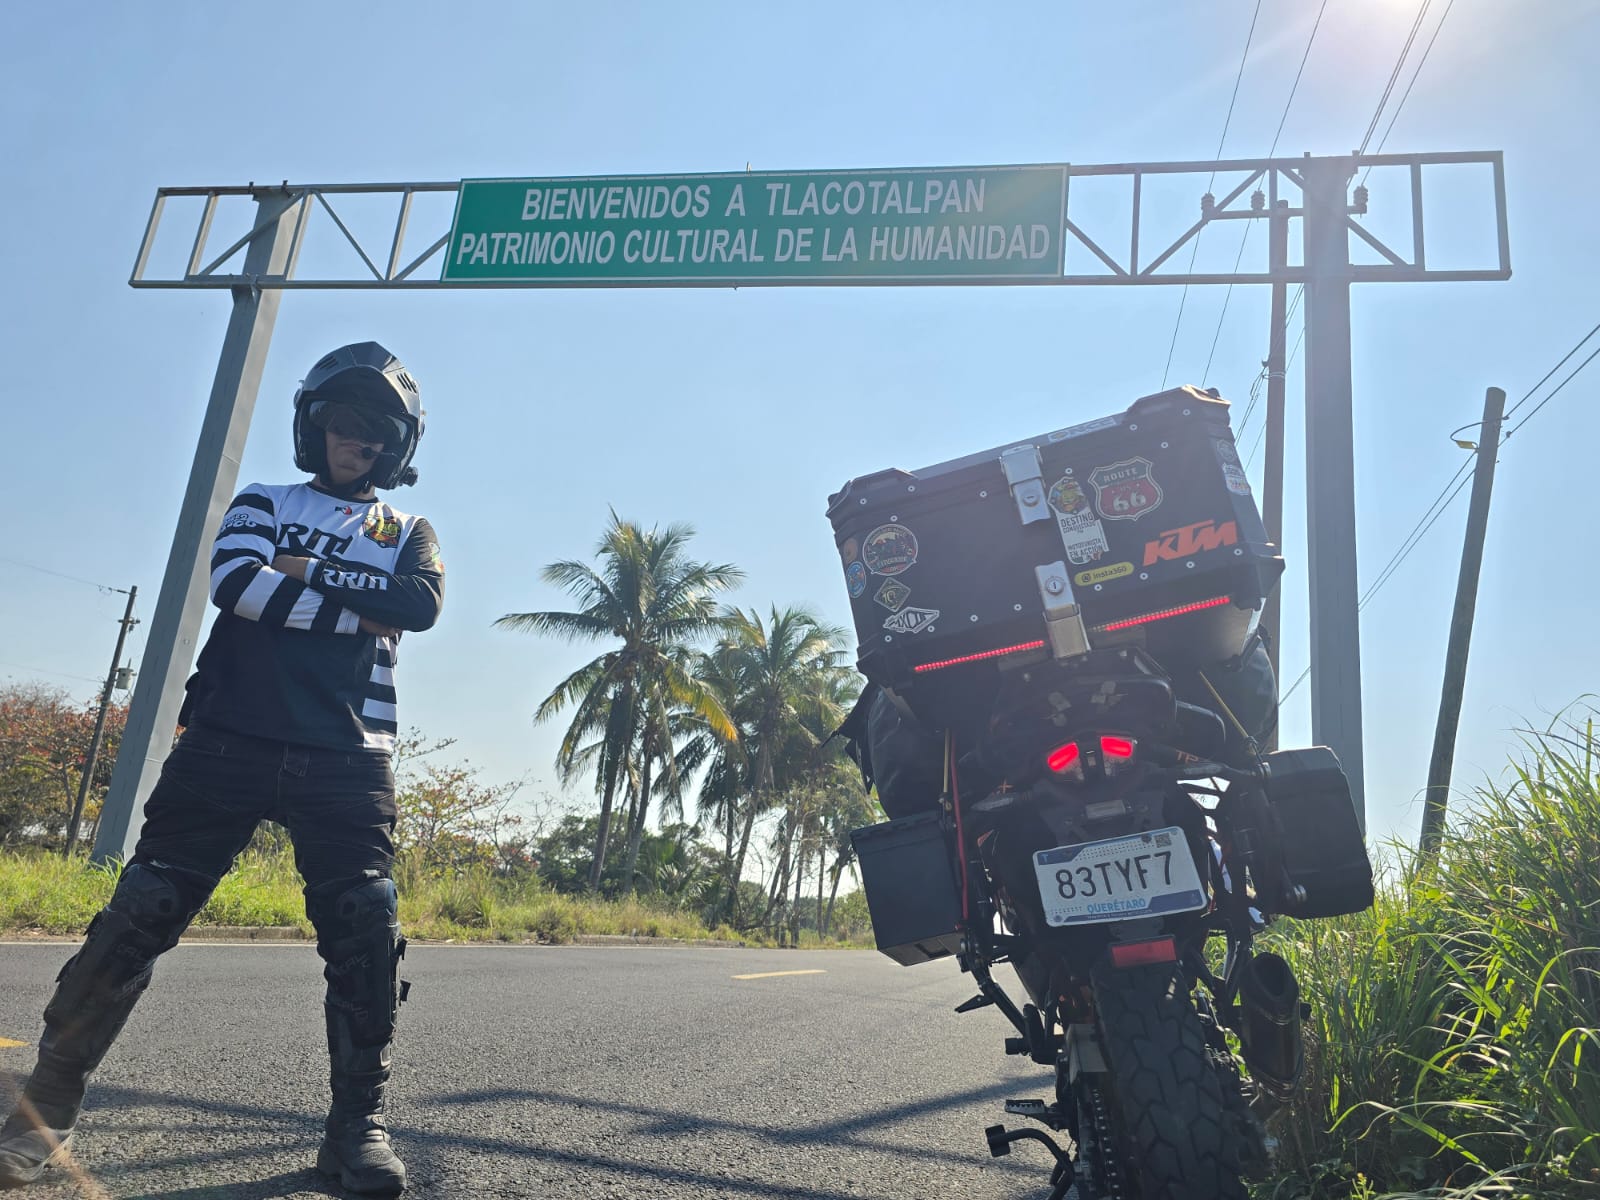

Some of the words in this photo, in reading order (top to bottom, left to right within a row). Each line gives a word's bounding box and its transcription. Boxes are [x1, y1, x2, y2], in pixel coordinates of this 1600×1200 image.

[521, 184, 712, 221] BIENVENIDOS
[725, 184, 746, 217] A
[766, 178, 986, 216] TLACOTALPAN
[456, 230, 616, 265] PATRIMONIO
[623, 229, 765, 264] CULTURAL
[774, 227, 814, 263] DE
[821, 227, 858, 262] LA
[869, 224, 1050, 261] HUMANIDAD
[1103, 467, 1138, 483] ROUTE
[1113, 492, 1147, 512] 66
[1060, 511, 1095, 528] DESTINO
[1143, 519, 1238, 567] KTM
[1093, 565, 1127, 580] insta360
[1055, 851, 1172, 899] 83TYF7
[1087, 898, 1146, 914] QUERÉTARO
